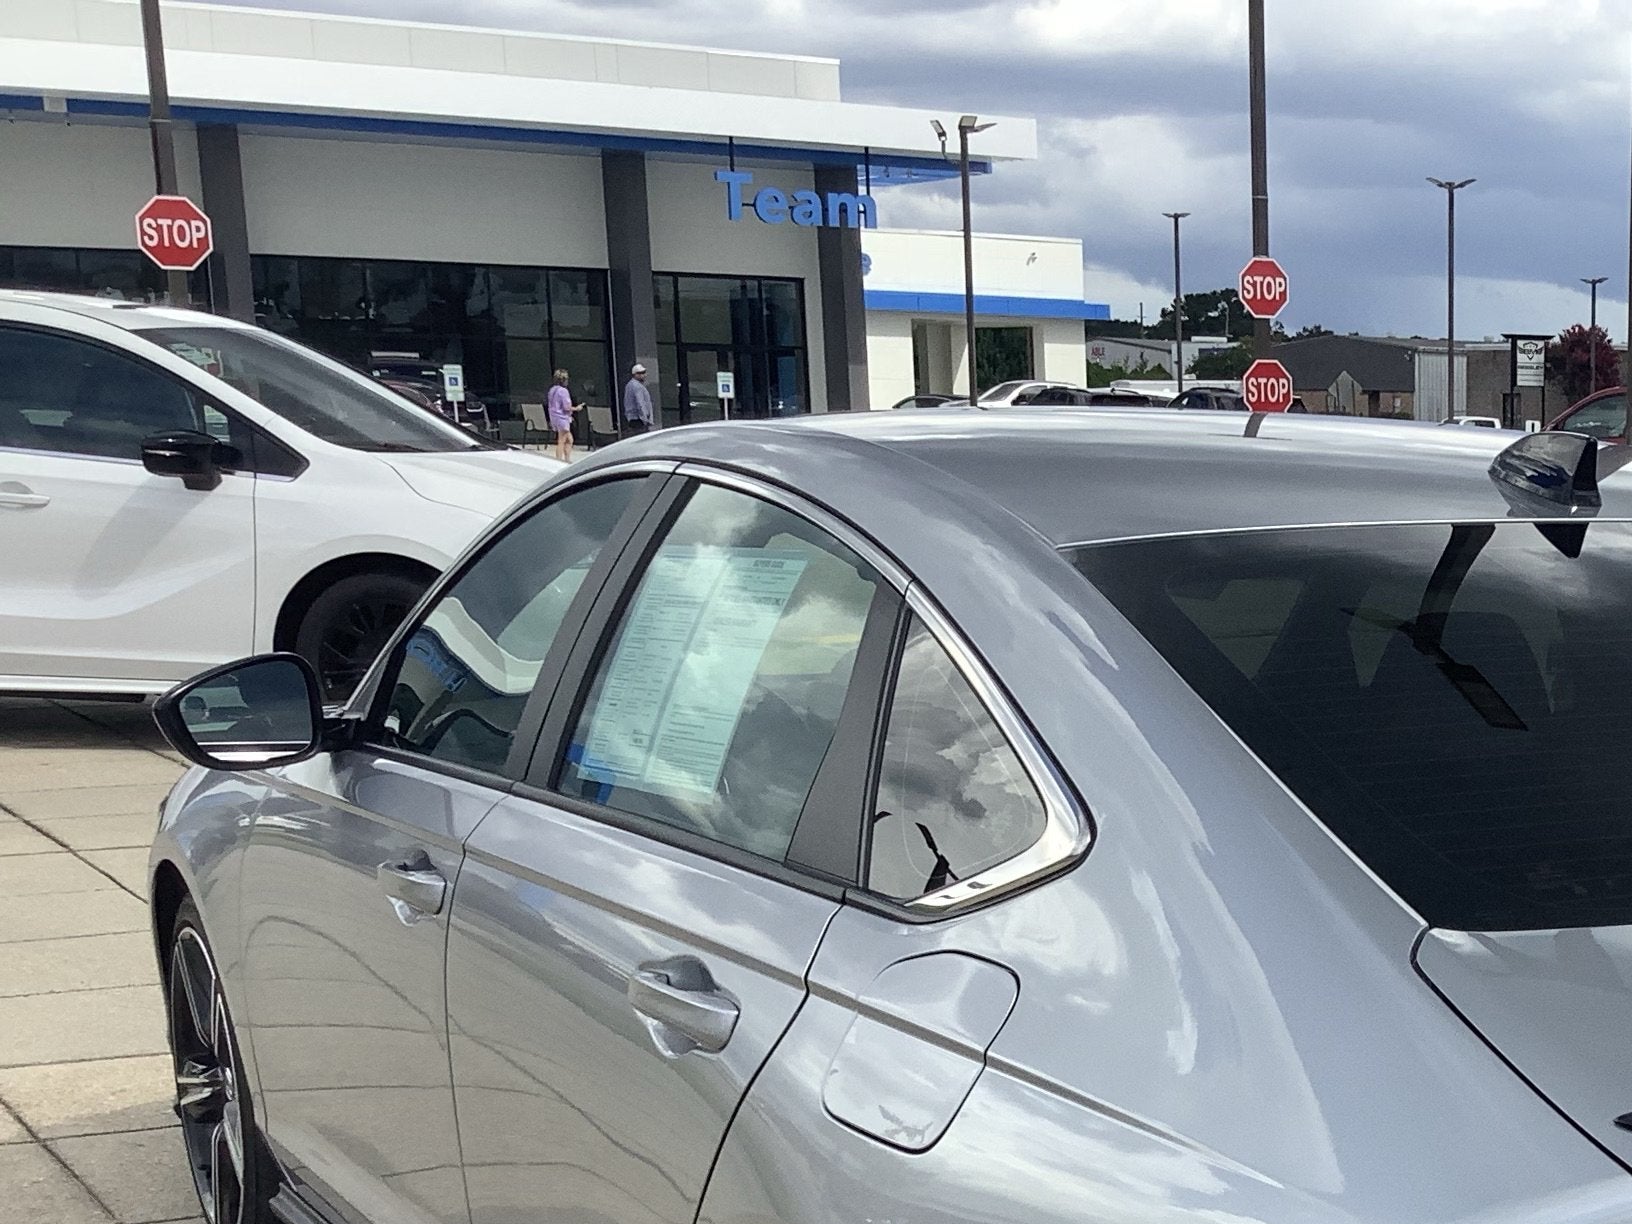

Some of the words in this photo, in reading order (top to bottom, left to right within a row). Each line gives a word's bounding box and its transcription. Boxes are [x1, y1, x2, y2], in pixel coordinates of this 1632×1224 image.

[714, 170, 878, 229] Team
[142, 217, 206, 249] STOP
[1243, 275, 1286, 301] STOP
[1248, 377, 1289, 403] STOP
